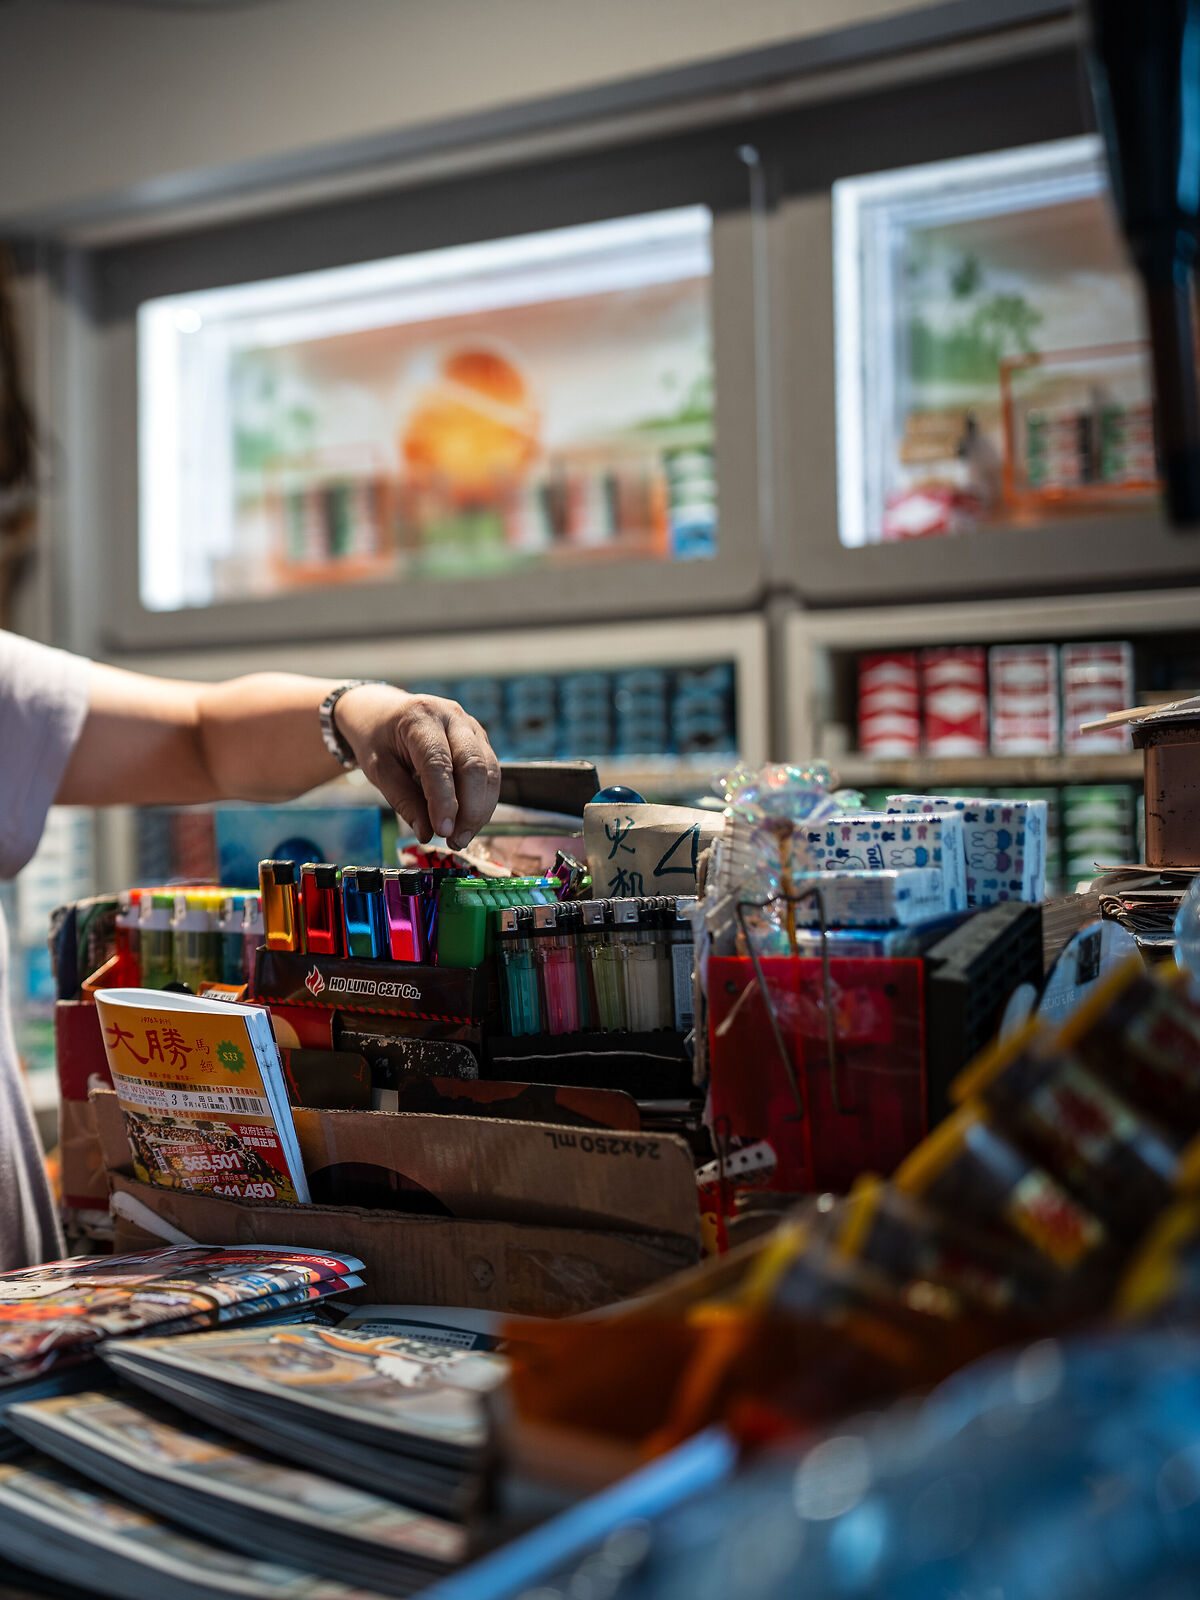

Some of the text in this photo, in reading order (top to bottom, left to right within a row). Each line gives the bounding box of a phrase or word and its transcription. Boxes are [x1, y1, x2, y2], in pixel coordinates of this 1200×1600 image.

[329, 976, 346, 991] HO
[346, 978, 376, 994] LUNG
[402, 983, 421, 1000] Co.
[105, 1022, 193, 1071] 大勝
[222, 1051, 239, 1062] $33
[130, 1085, 167, 1098] WINNER
[171, 1094, 178, 1106] 3
[181, 1152, 242, 1173] $65,501
